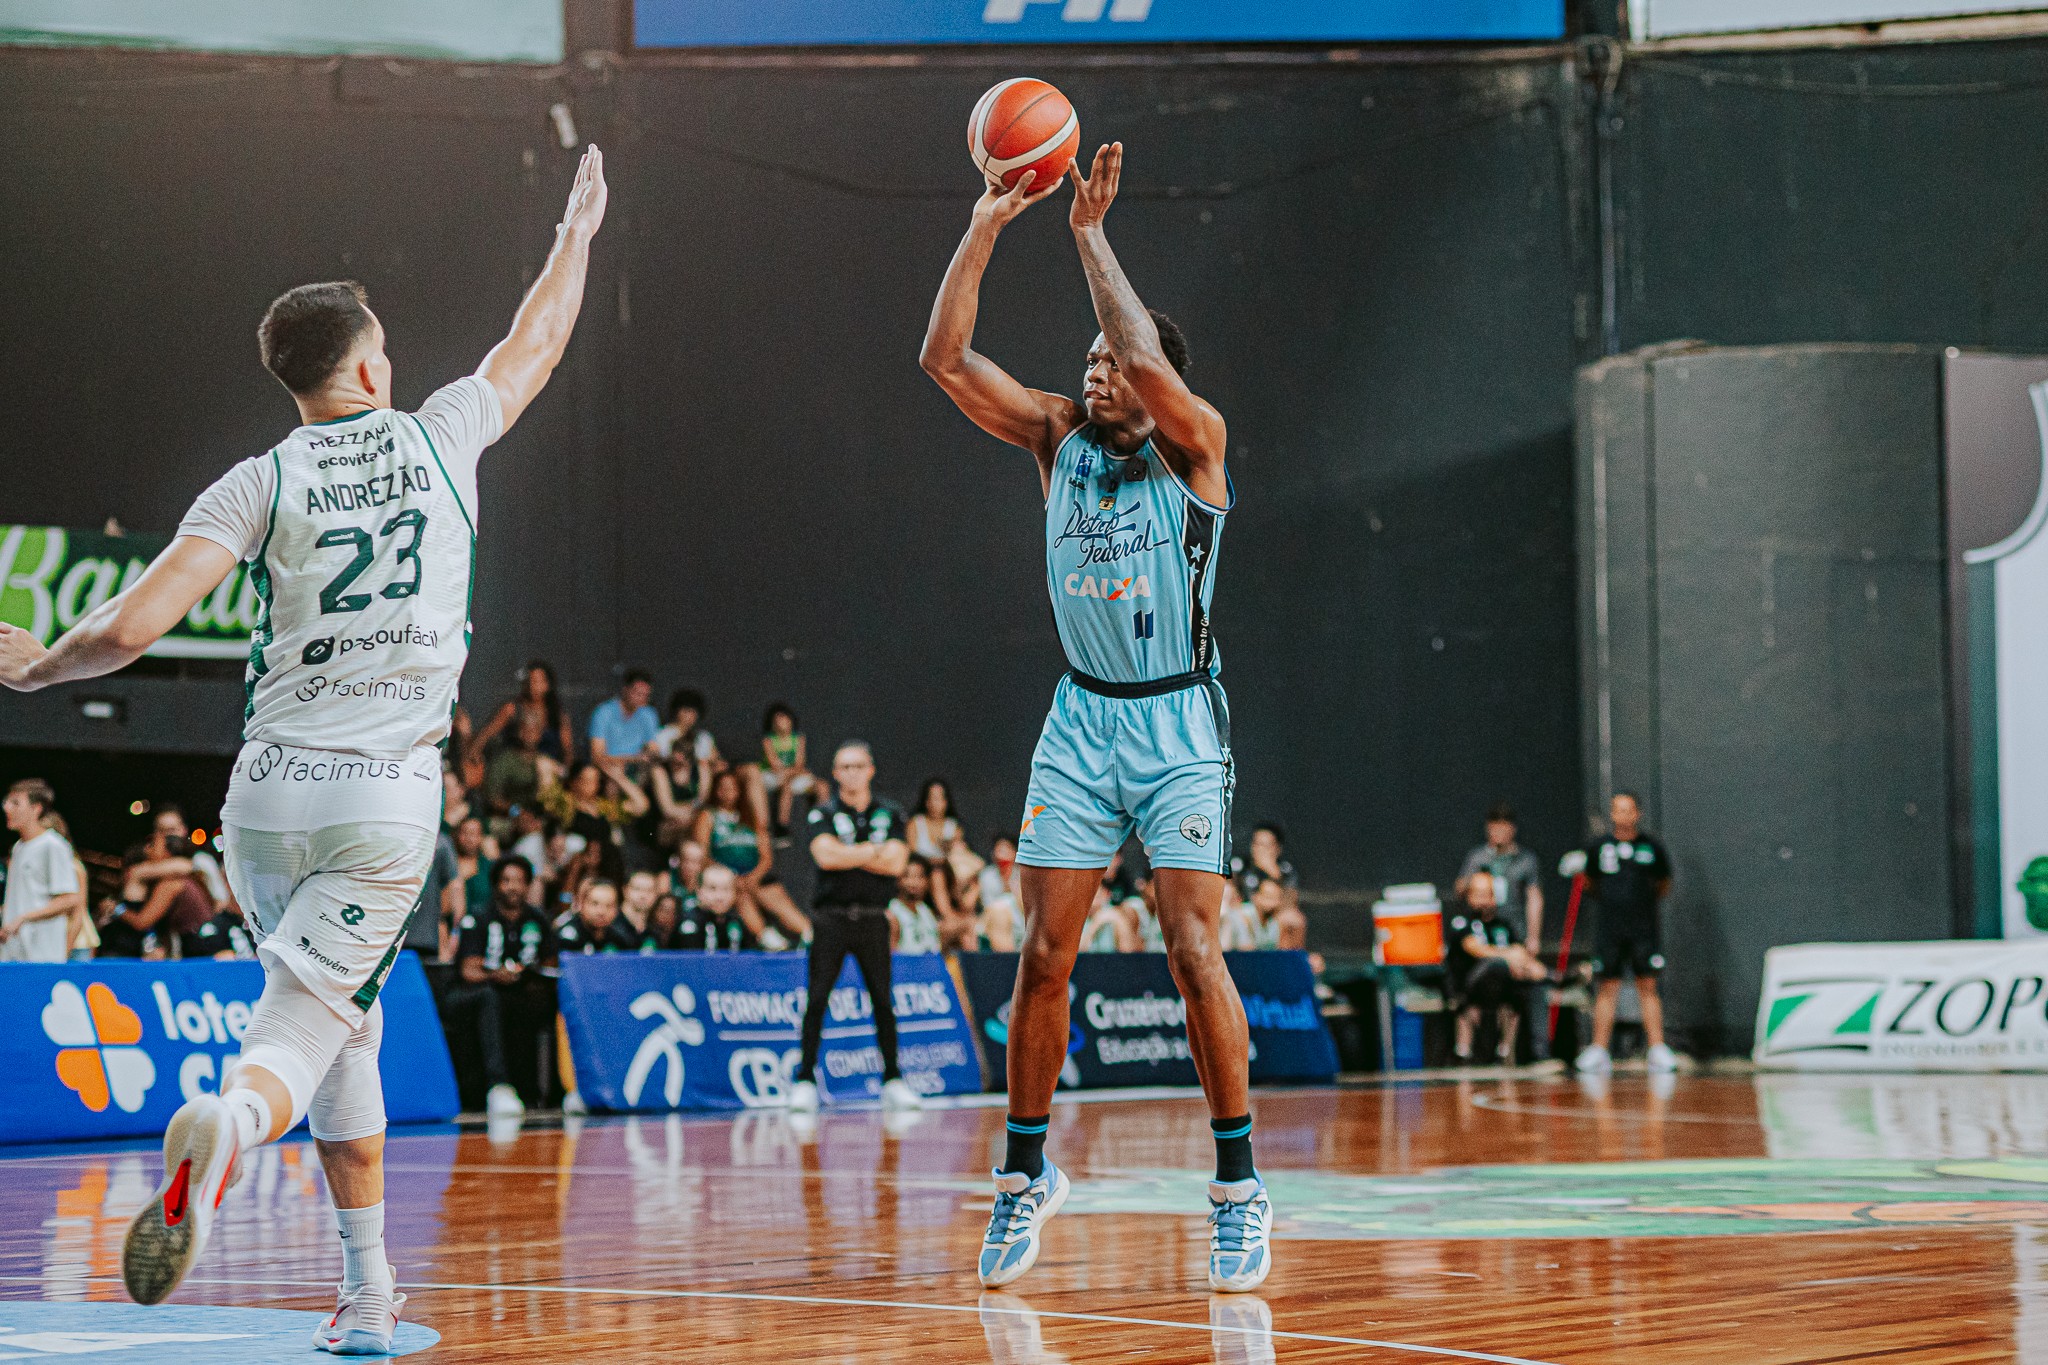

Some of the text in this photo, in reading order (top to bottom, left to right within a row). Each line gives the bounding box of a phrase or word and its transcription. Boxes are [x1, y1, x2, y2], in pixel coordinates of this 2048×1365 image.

[317, 451, 378, 470] ecovita
[306, 464, 431, 515] ANDREZÃO
[1076, 519, 1170, 569] Federal
[315, 508, 428, 615] 23
[1064, 572, 1151, 601] CAIXA
[330, 676, 426, 701] facimus
[400, 673, 427, 684] grupo
[282, 755, 400, 782] facimus
[307, 947, 349, 975] Provém
[151, 981, 261, 1044] lote
[1887, 976, 2048, 1037] ZOP
